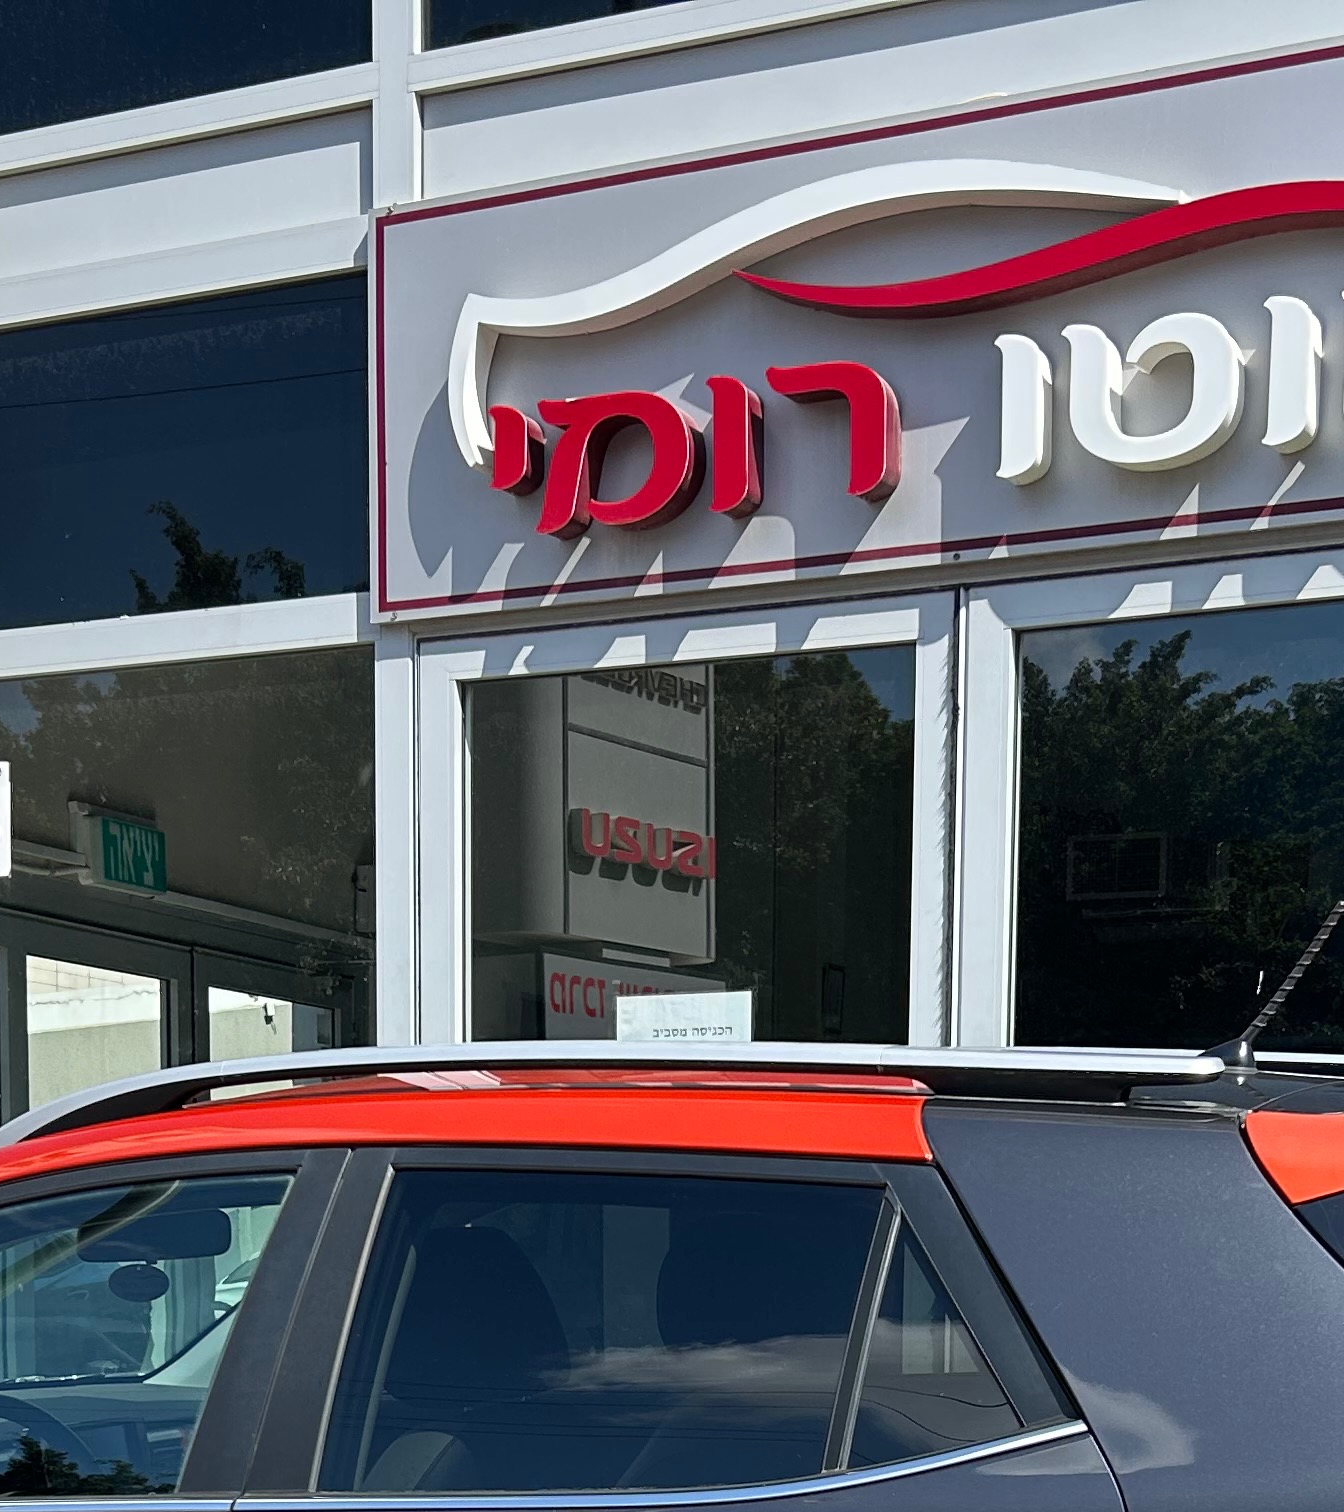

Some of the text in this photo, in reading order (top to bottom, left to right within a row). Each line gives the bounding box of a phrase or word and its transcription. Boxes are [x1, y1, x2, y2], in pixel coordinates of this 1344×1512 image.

[489, 359, 902, 541] רומי
[108, 822, 160, 887] יציאה
[652, 1026, 733, 1038] הכניסה מסביב
